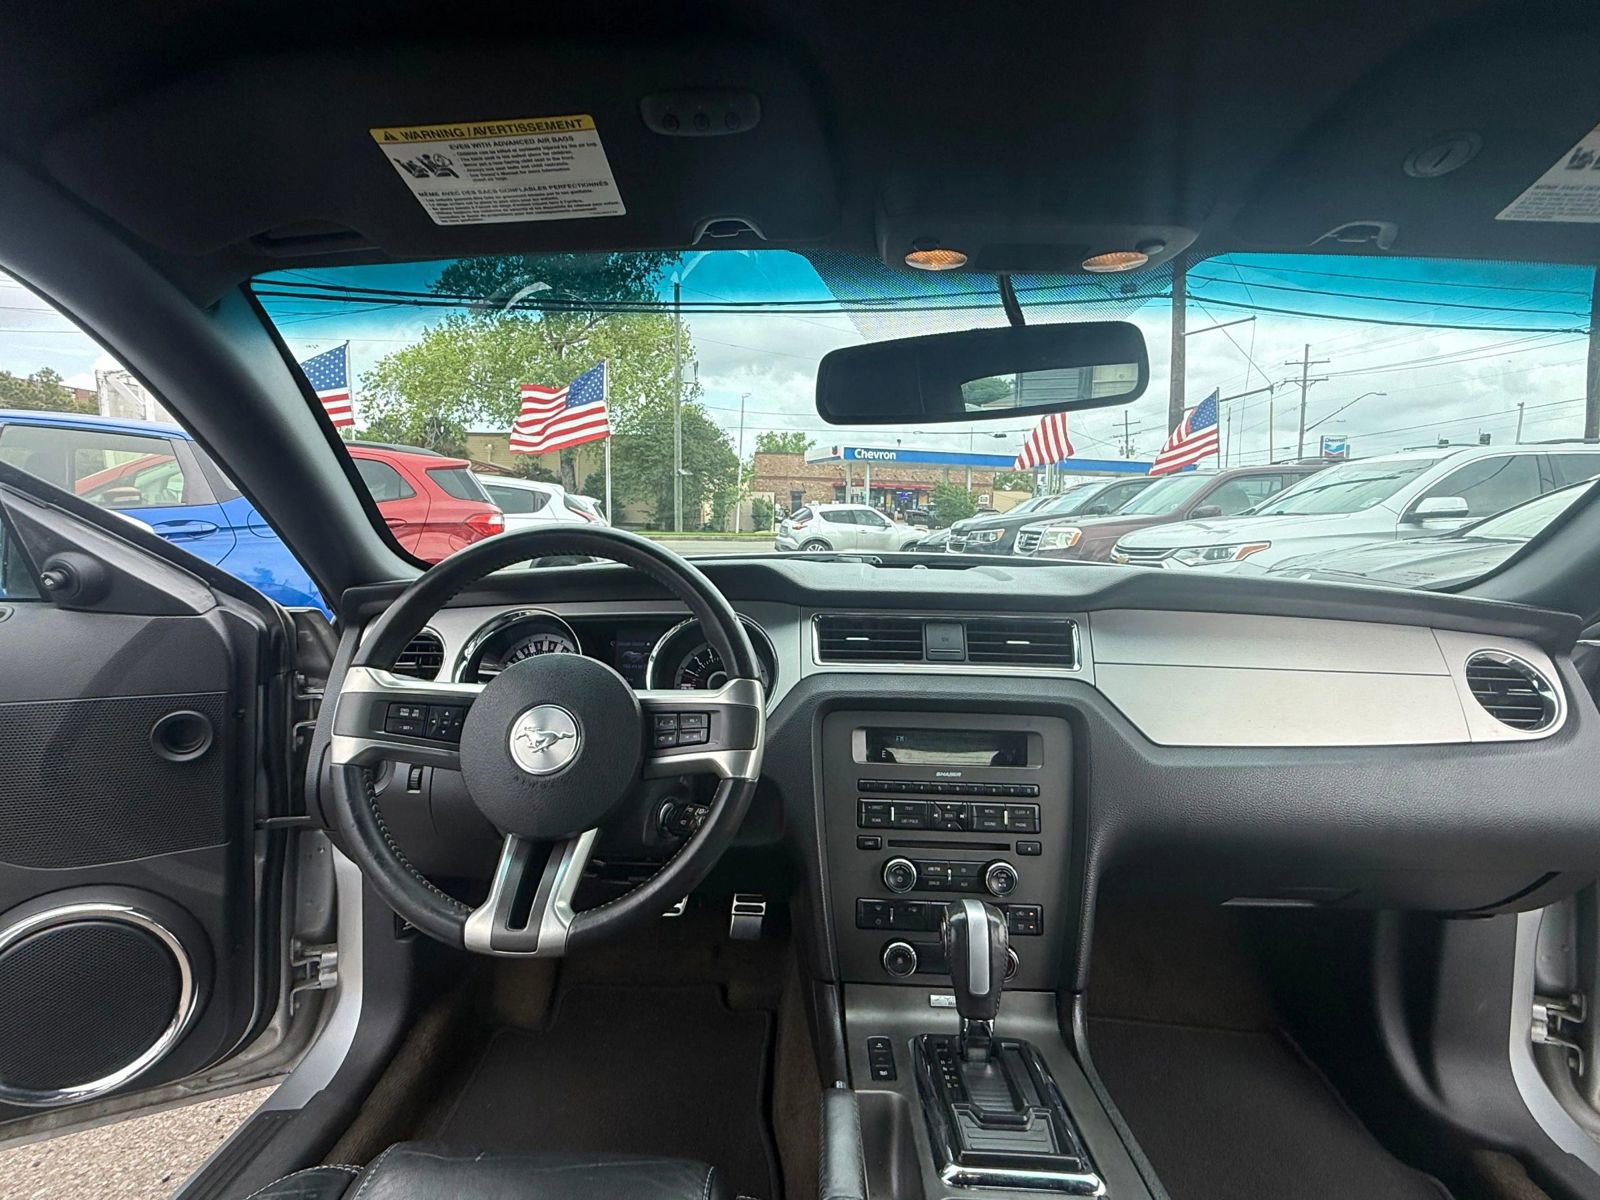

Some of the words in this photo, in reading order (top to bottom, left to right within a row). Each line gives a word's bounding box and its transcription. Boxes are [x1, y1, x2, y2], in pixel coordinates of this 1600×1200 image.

[400, 128, 464, 140] WARNING
[494, 138, 535, 147] ADVANCED
[854, 448, 896, 460] Chevron
